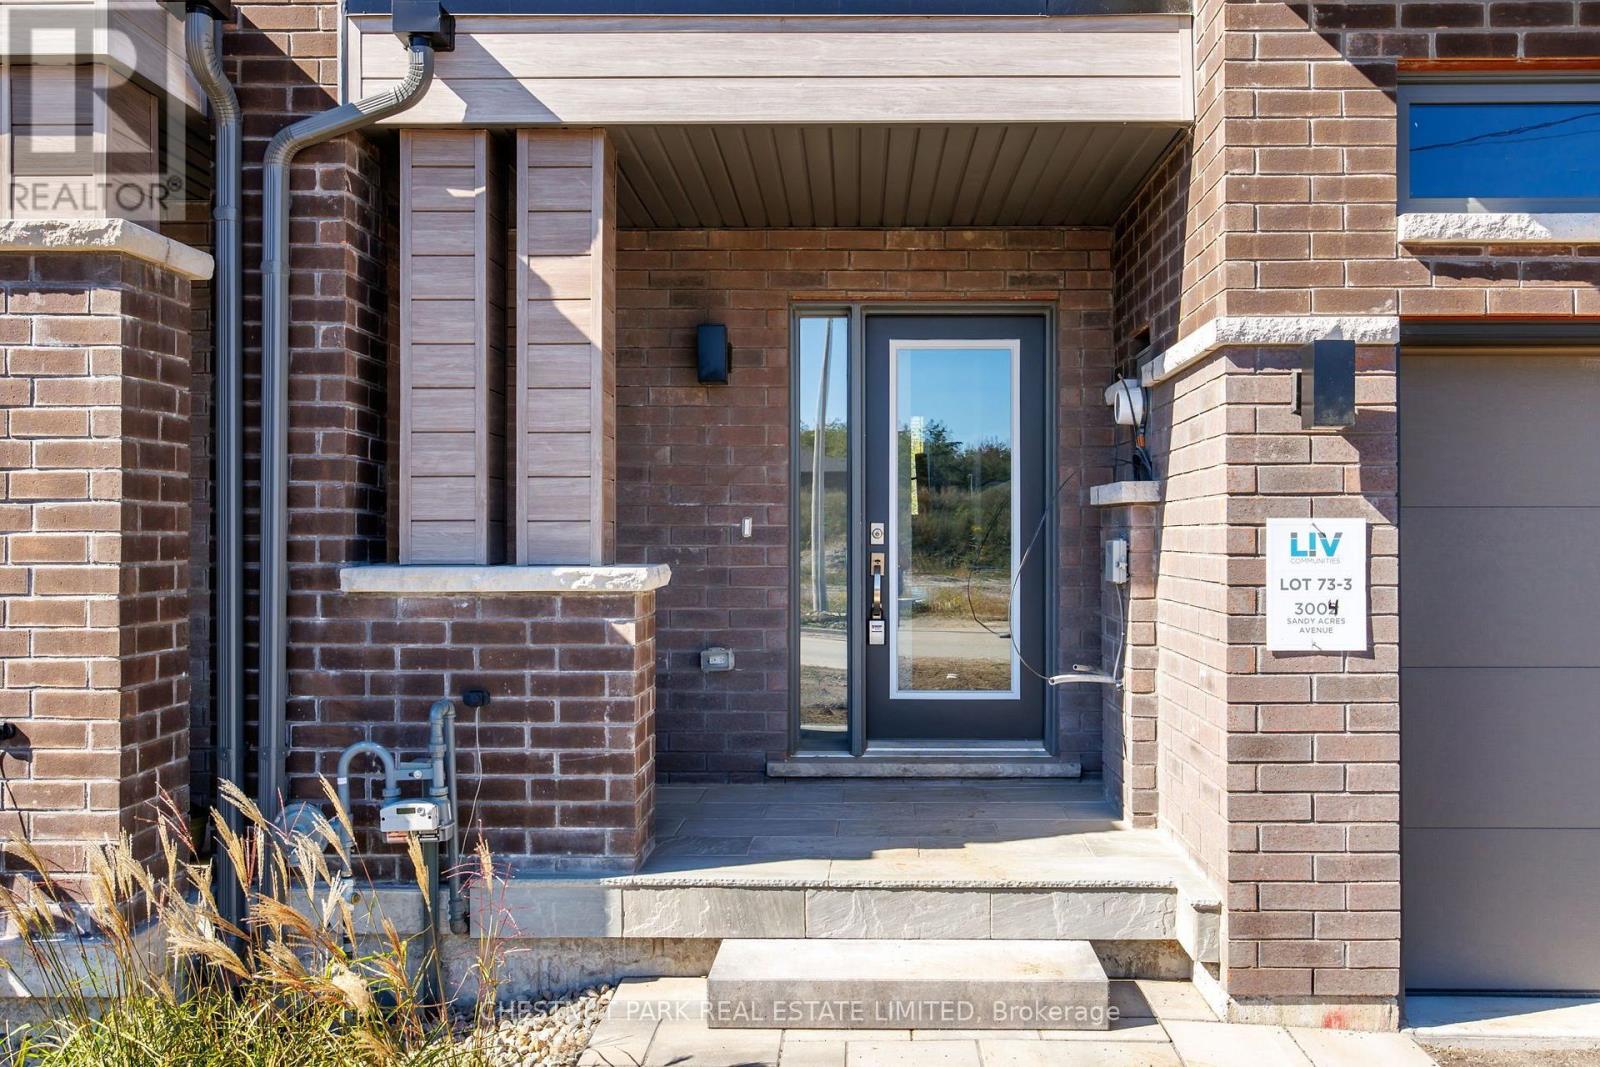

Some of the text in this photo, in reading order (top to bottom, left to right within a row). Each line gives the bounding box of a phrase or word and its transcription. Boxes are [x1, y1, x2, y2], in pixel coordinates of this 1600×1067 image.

[1280, 578, 1352, 591] LOT 73-3
[1294, 600, 1339, 616] 3004
[1287, 617, 1346, 625] SANDY ACRES
